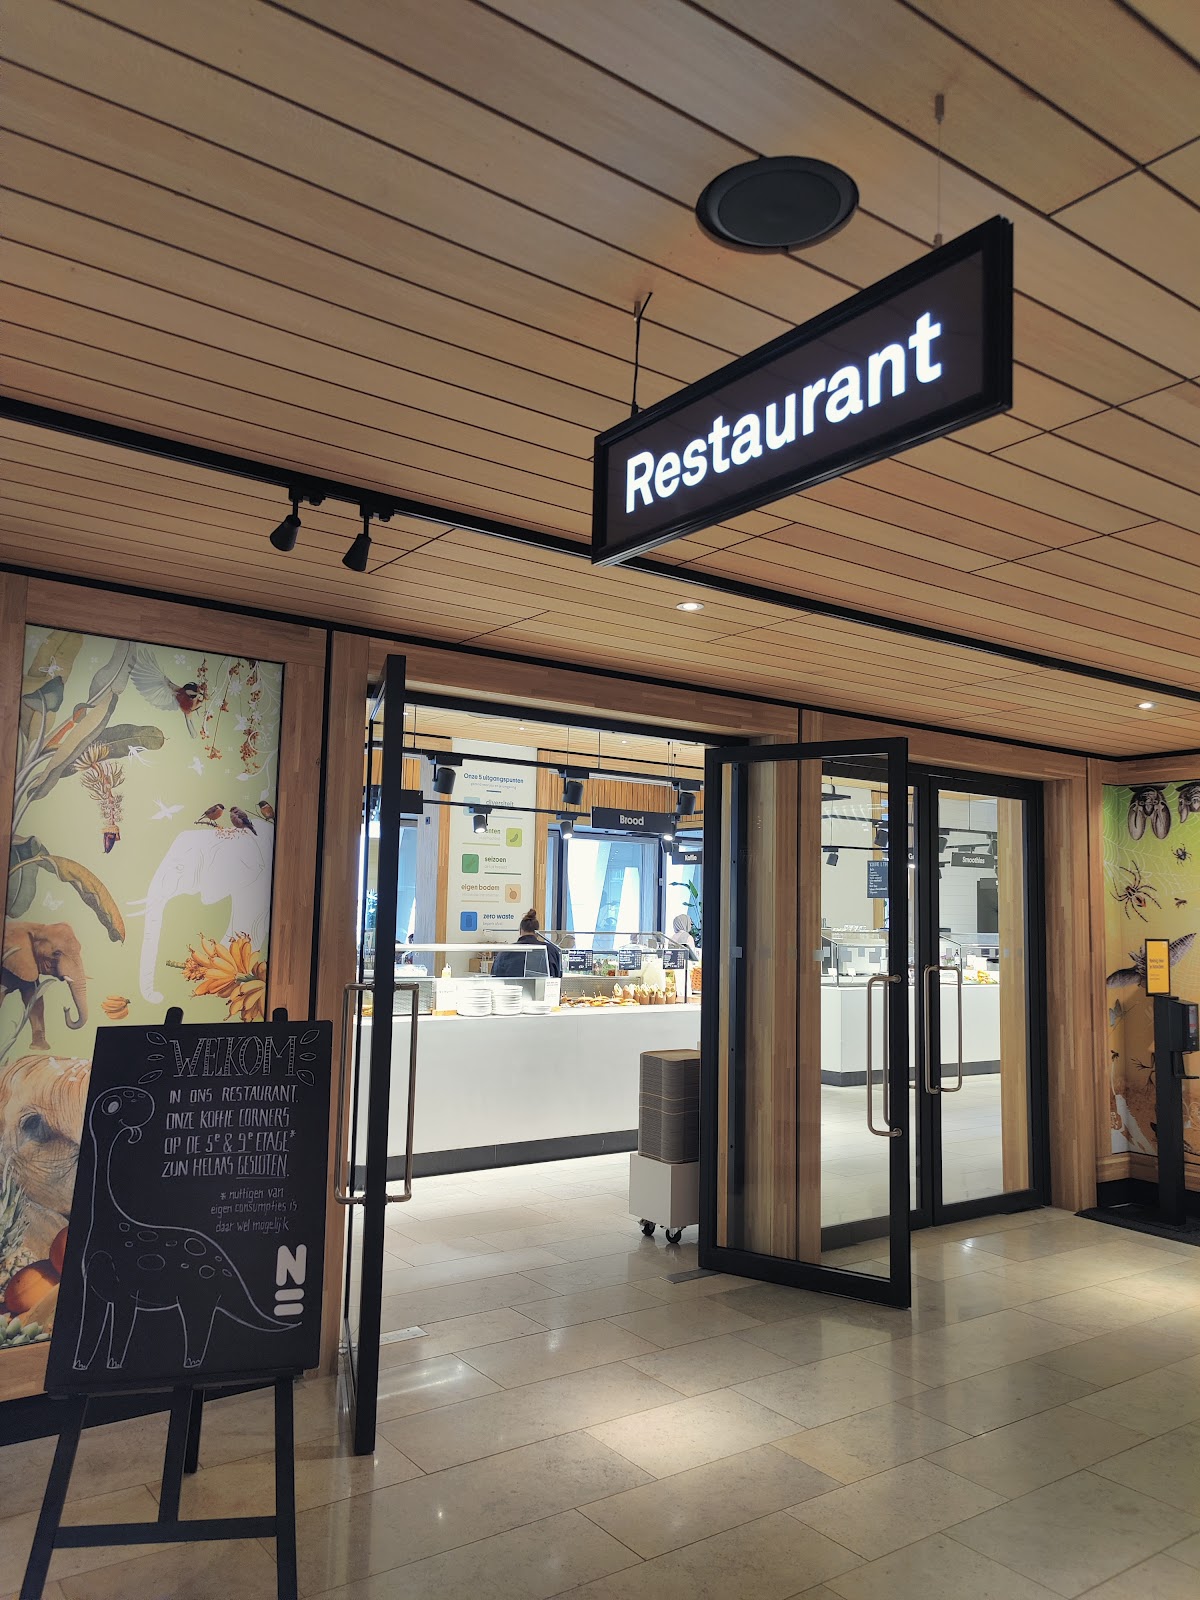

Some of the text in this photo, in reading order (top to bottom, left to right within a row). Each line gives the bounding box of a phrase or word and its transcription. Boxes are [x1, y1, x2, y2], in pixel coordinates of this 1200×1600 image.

[625, 311, 942, 514] Restaurant
[463, 772, 478, 780] Onze
[619, 815, 645, 826] Brood
[962, 856, 985, 864] Smoothies
[461, 884, 478, 892] eigen
[169, 1035, 298, 1078] WELKOM
[169, 1085, 299, 1104] IN ONS RESTAURANT.
[166, 1107, 290, 1130] ONZE KOFFIE CORNERS
[164, 1136, 181, 1155] OP
[187, 1135, 201, 1155] DE
[223, 1132, 233, 1153] &
[193, 1156, 234, 1176] HELAAS
[268, 1187, 284, 1198] van
[210, 1198, 298, 1219] eigen consumpties is
[215, 1216, 290, 1235] daar wel mogelijk
